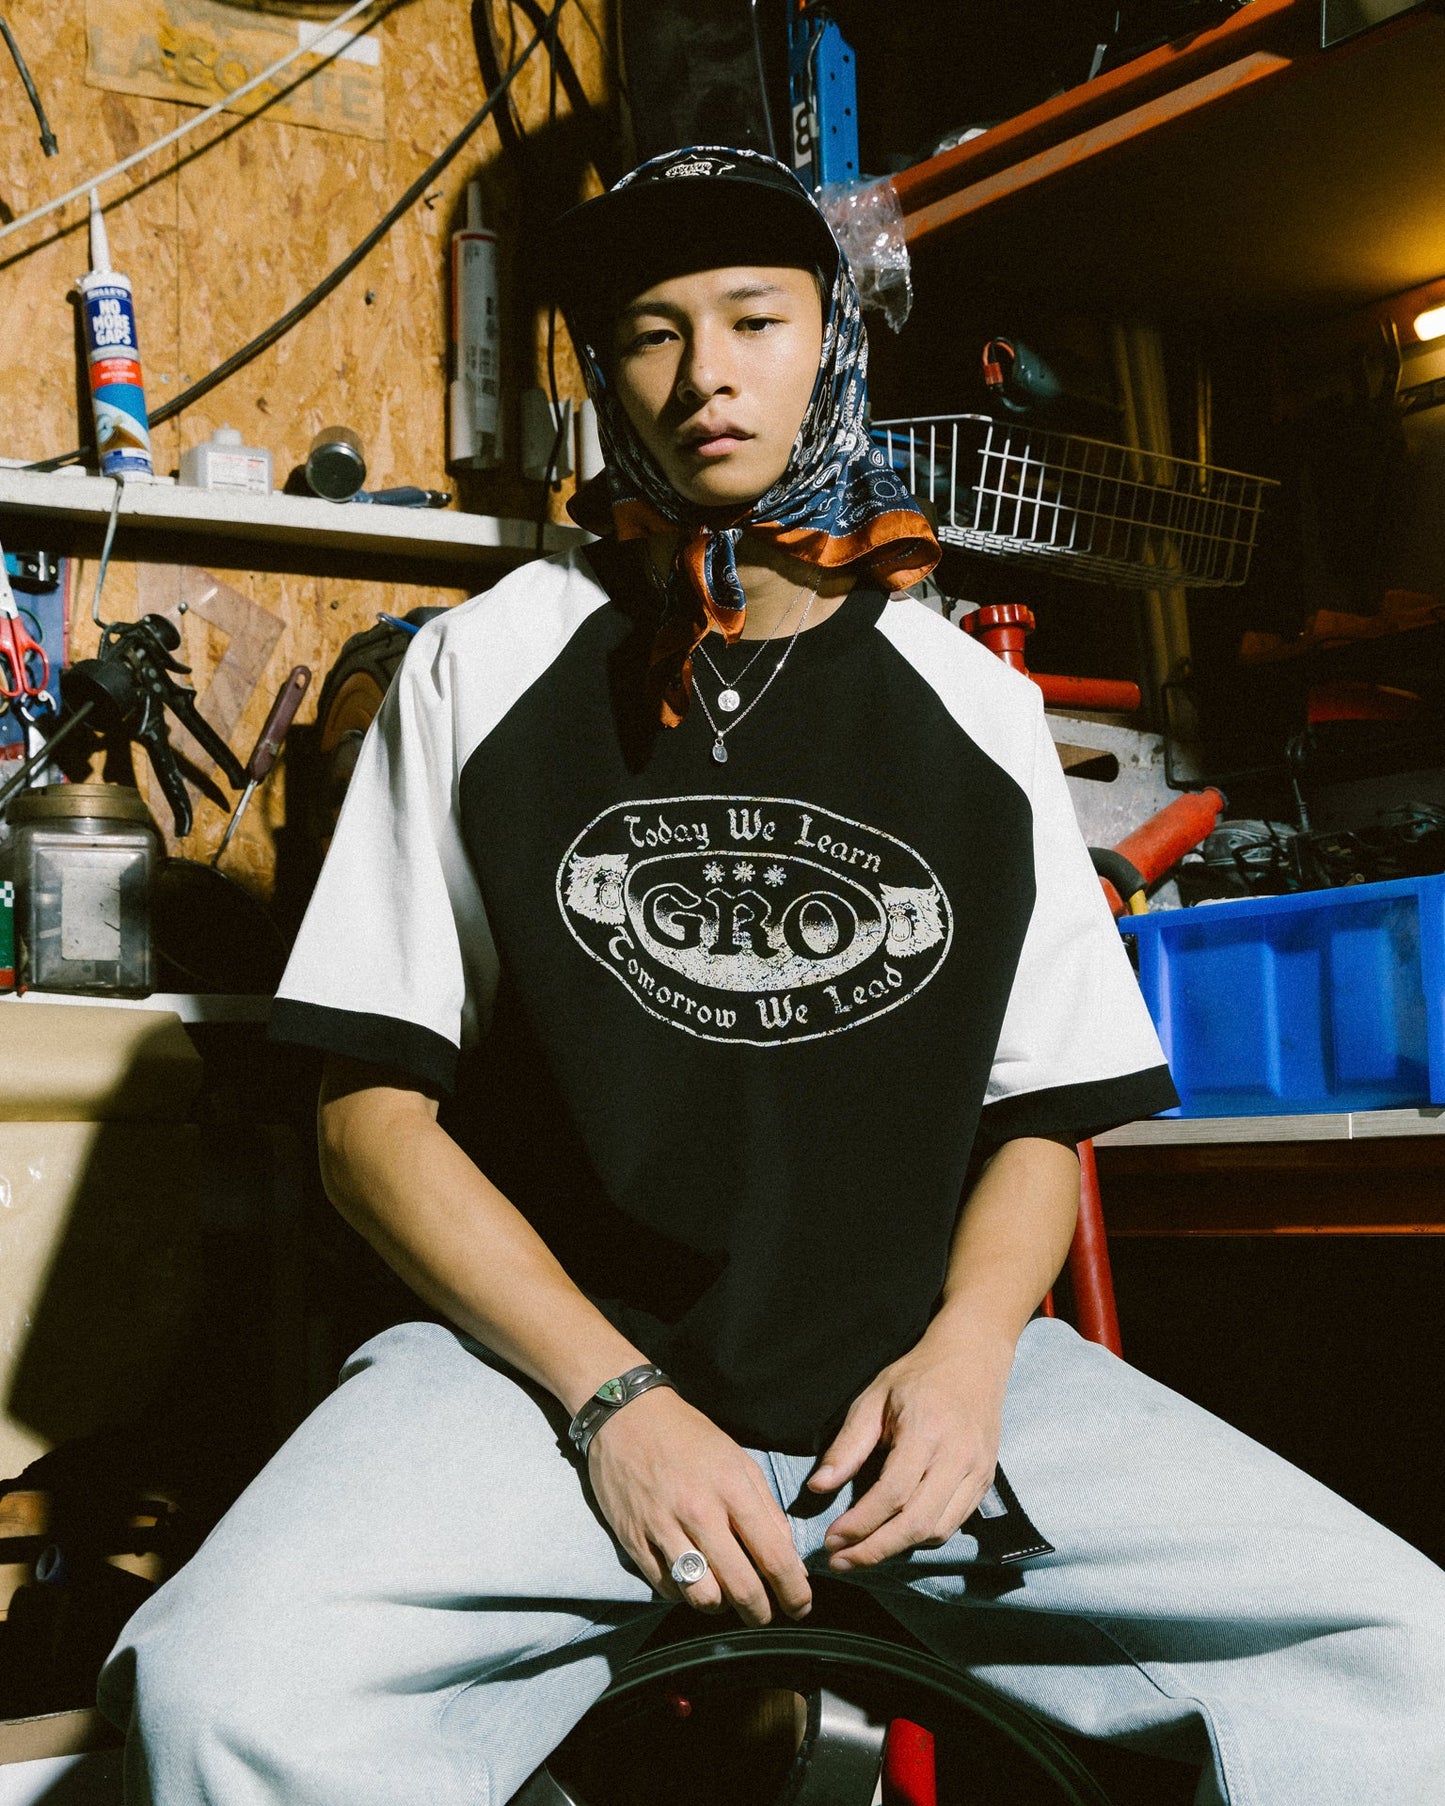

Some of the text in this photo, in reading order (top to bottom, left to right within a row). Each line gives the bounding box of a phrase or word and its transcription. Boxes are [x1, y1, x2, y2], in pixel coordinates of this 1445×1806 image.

[92, 313, 130, 334] MORE
[99, 299, 121, 315] NO
[95, 329, 132, 346] GAPS
[624, 808, 882, 873] Today We Learn
[641, 882, 858, 961] GRO
[608, 926, 904, 1029] Tomorrow We Lead
